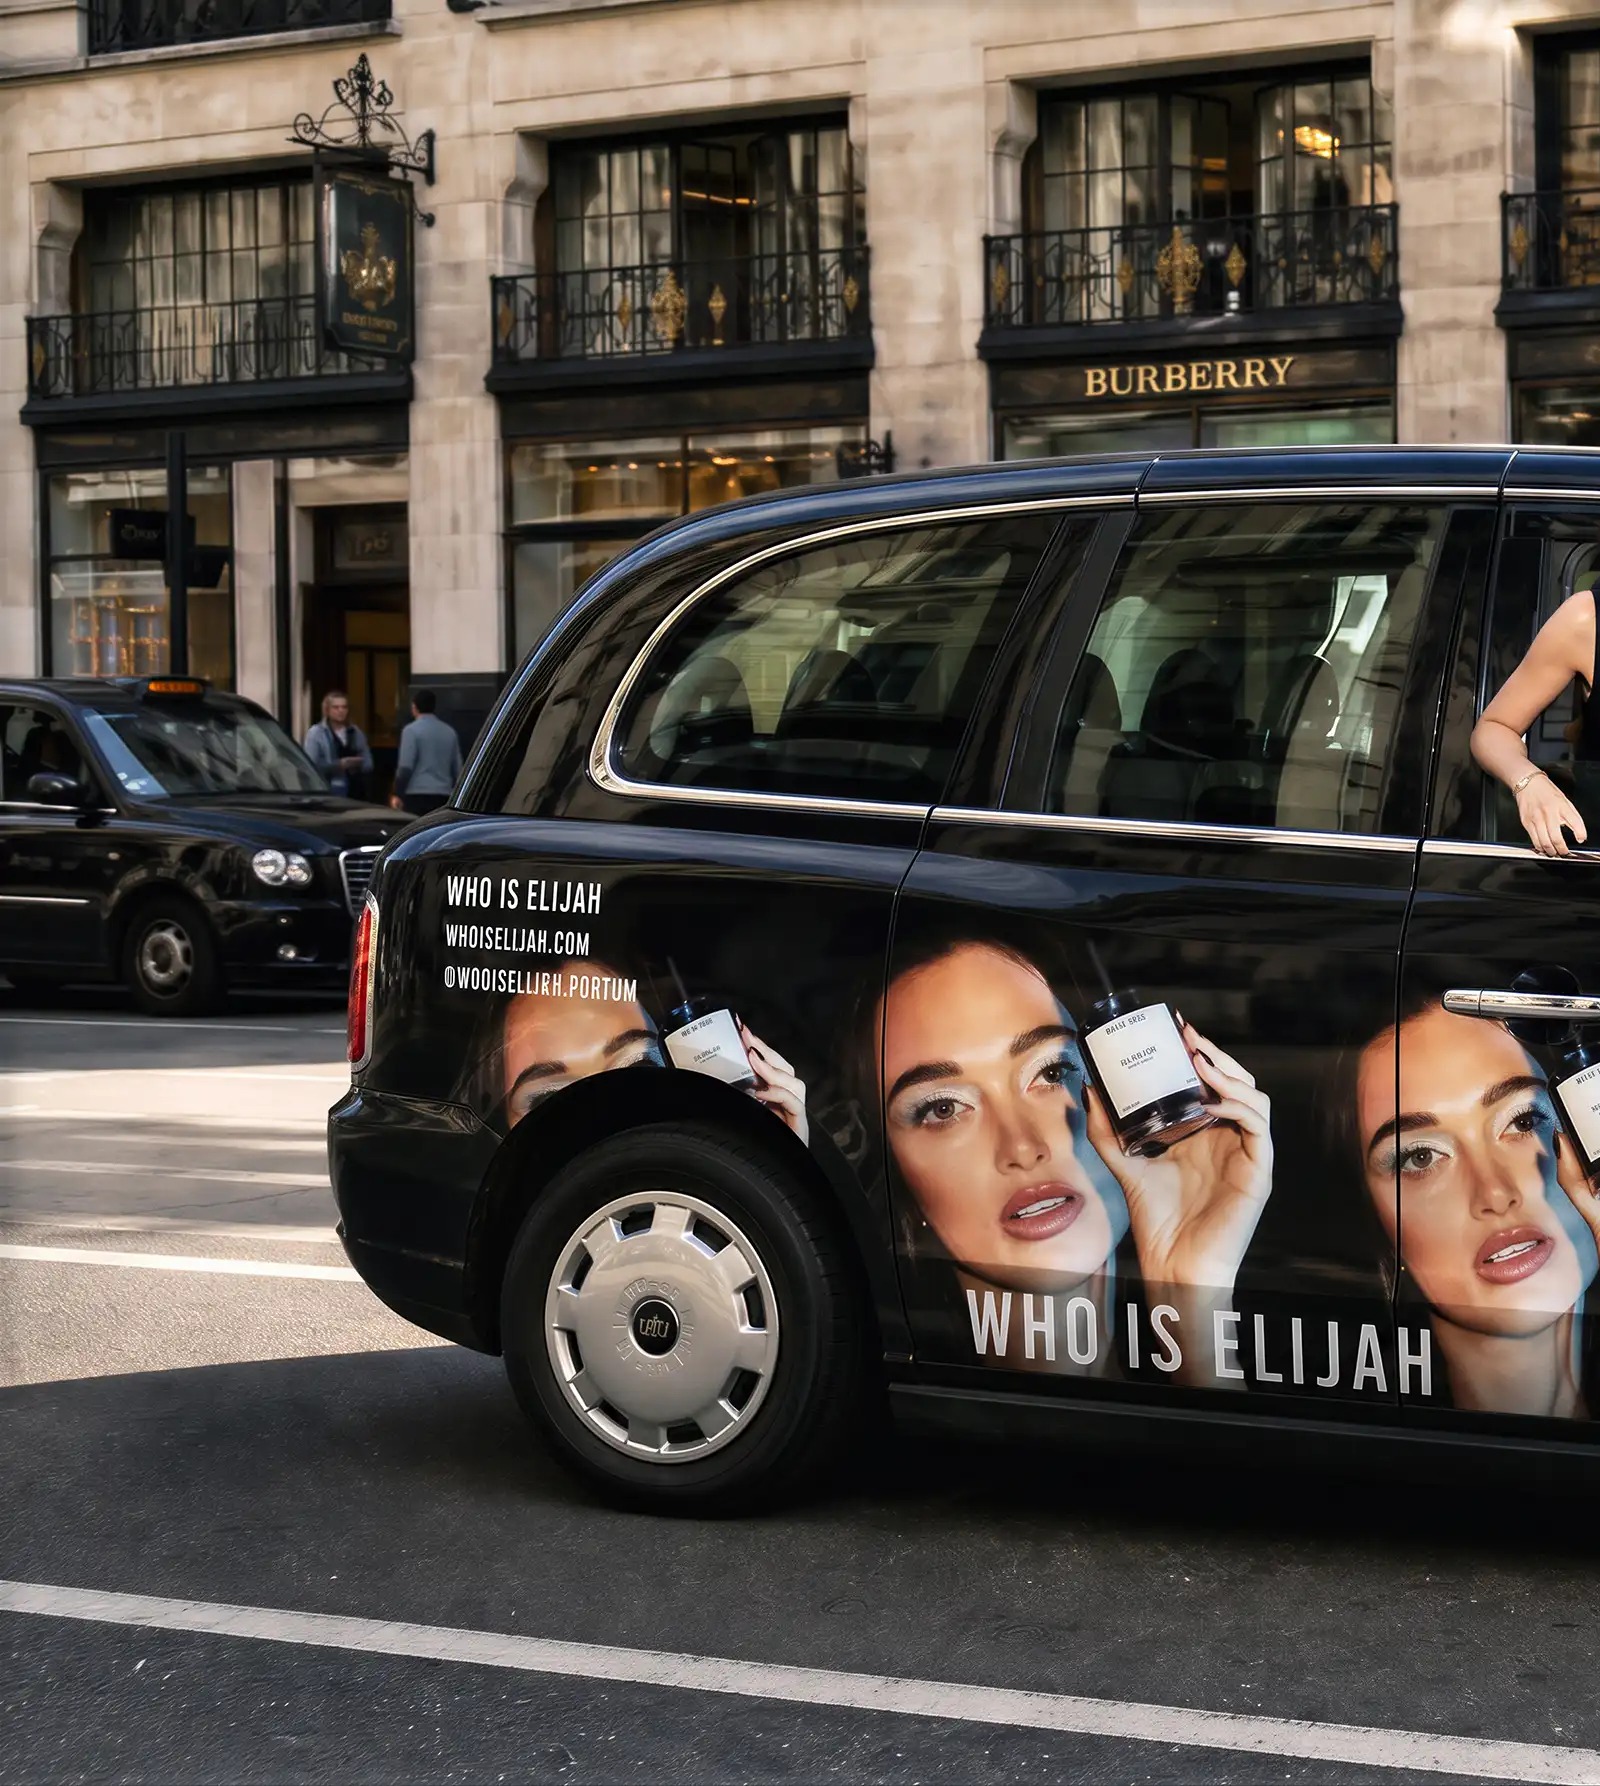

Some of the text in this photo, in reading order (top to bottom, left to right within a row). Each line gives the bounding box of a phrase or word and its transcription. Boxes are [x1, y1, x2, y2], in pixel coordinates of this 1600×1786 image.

[1085, 356, 1294, 396] BURBERRY
[447, 875, 602, 914] WHO IS ELIJAH
[966, 1289, 1433, 1396] WHO IS ELIJAH
